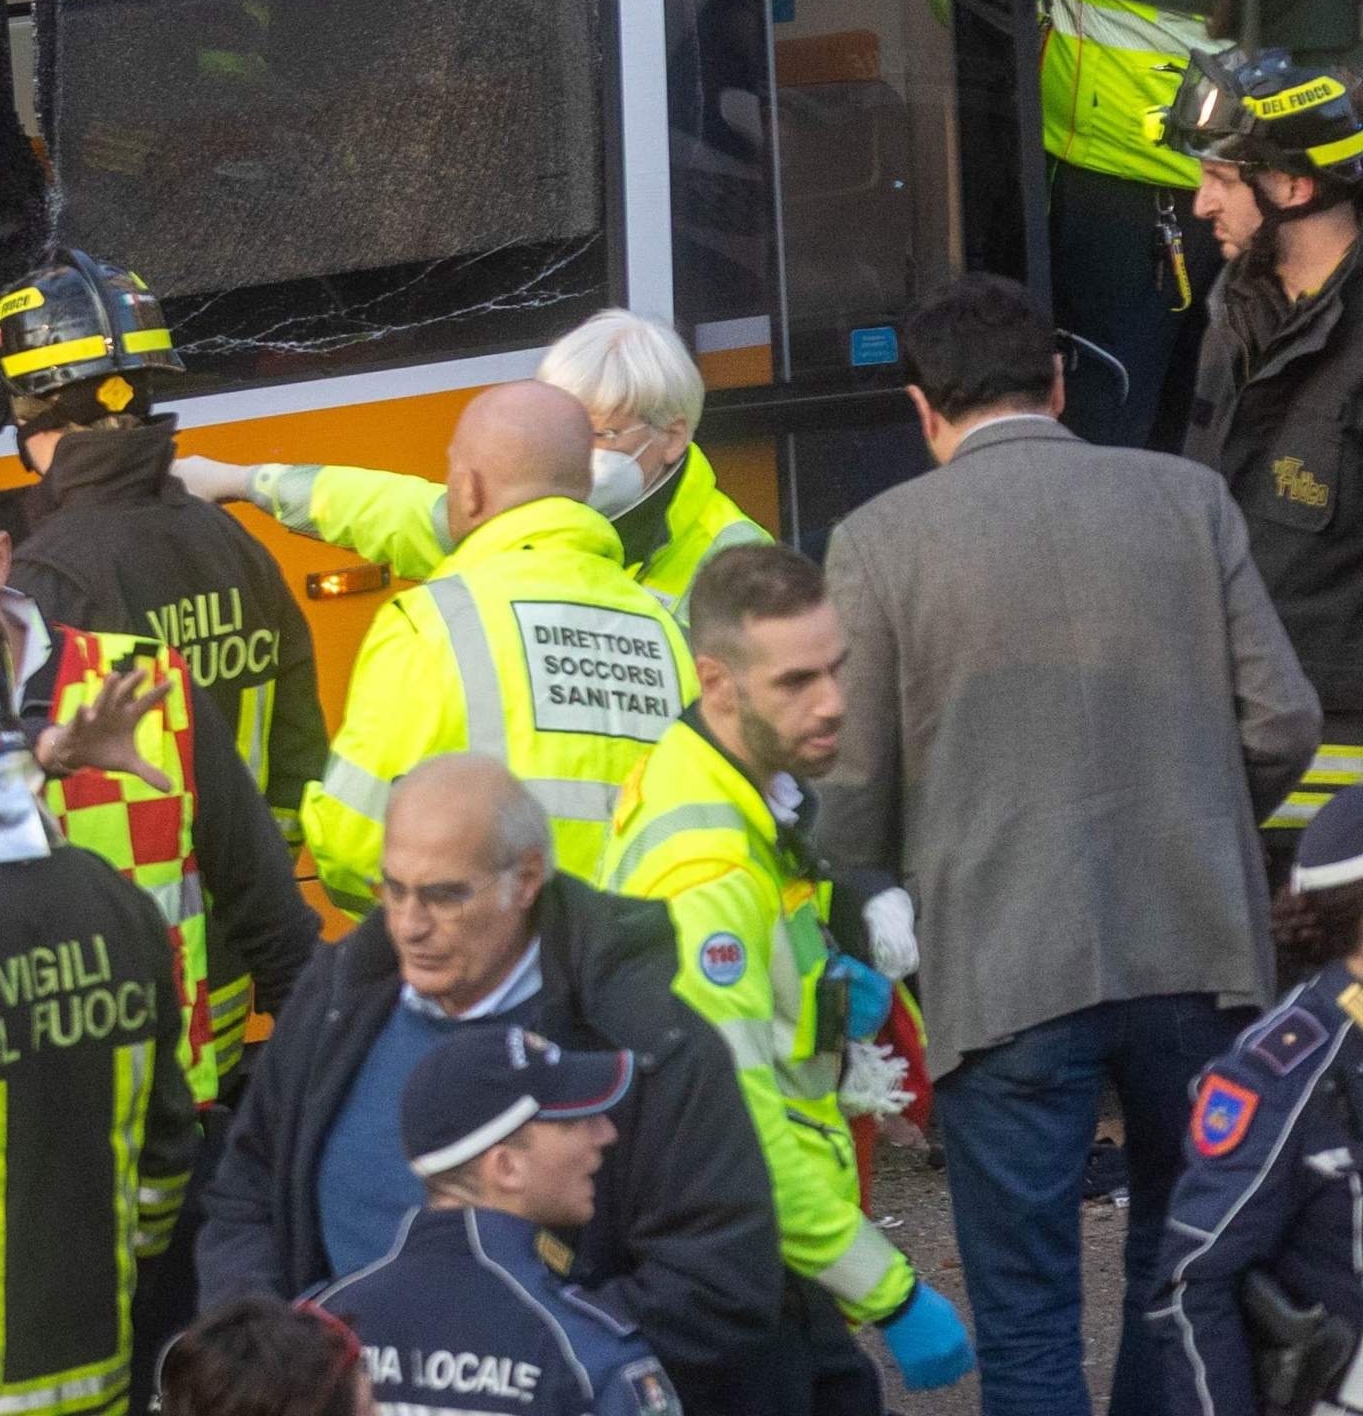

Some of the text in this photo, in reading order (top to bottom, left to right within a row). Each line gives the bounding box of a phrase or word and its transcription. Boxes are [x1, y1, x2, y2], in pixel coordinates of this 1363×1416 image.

[1261, 97, 1286, 115] DEL
[1289, 83, 1333, 108] FUOCO
[145, 587, 243, 649] VIGILI
[534, 625, 663, 661] DIRETTORE
[544, 655, 666, 688] SOCCORSI
[548, 684, 671, 719] SANITARI
[411, 1348, 543, 1405] LOCALE
